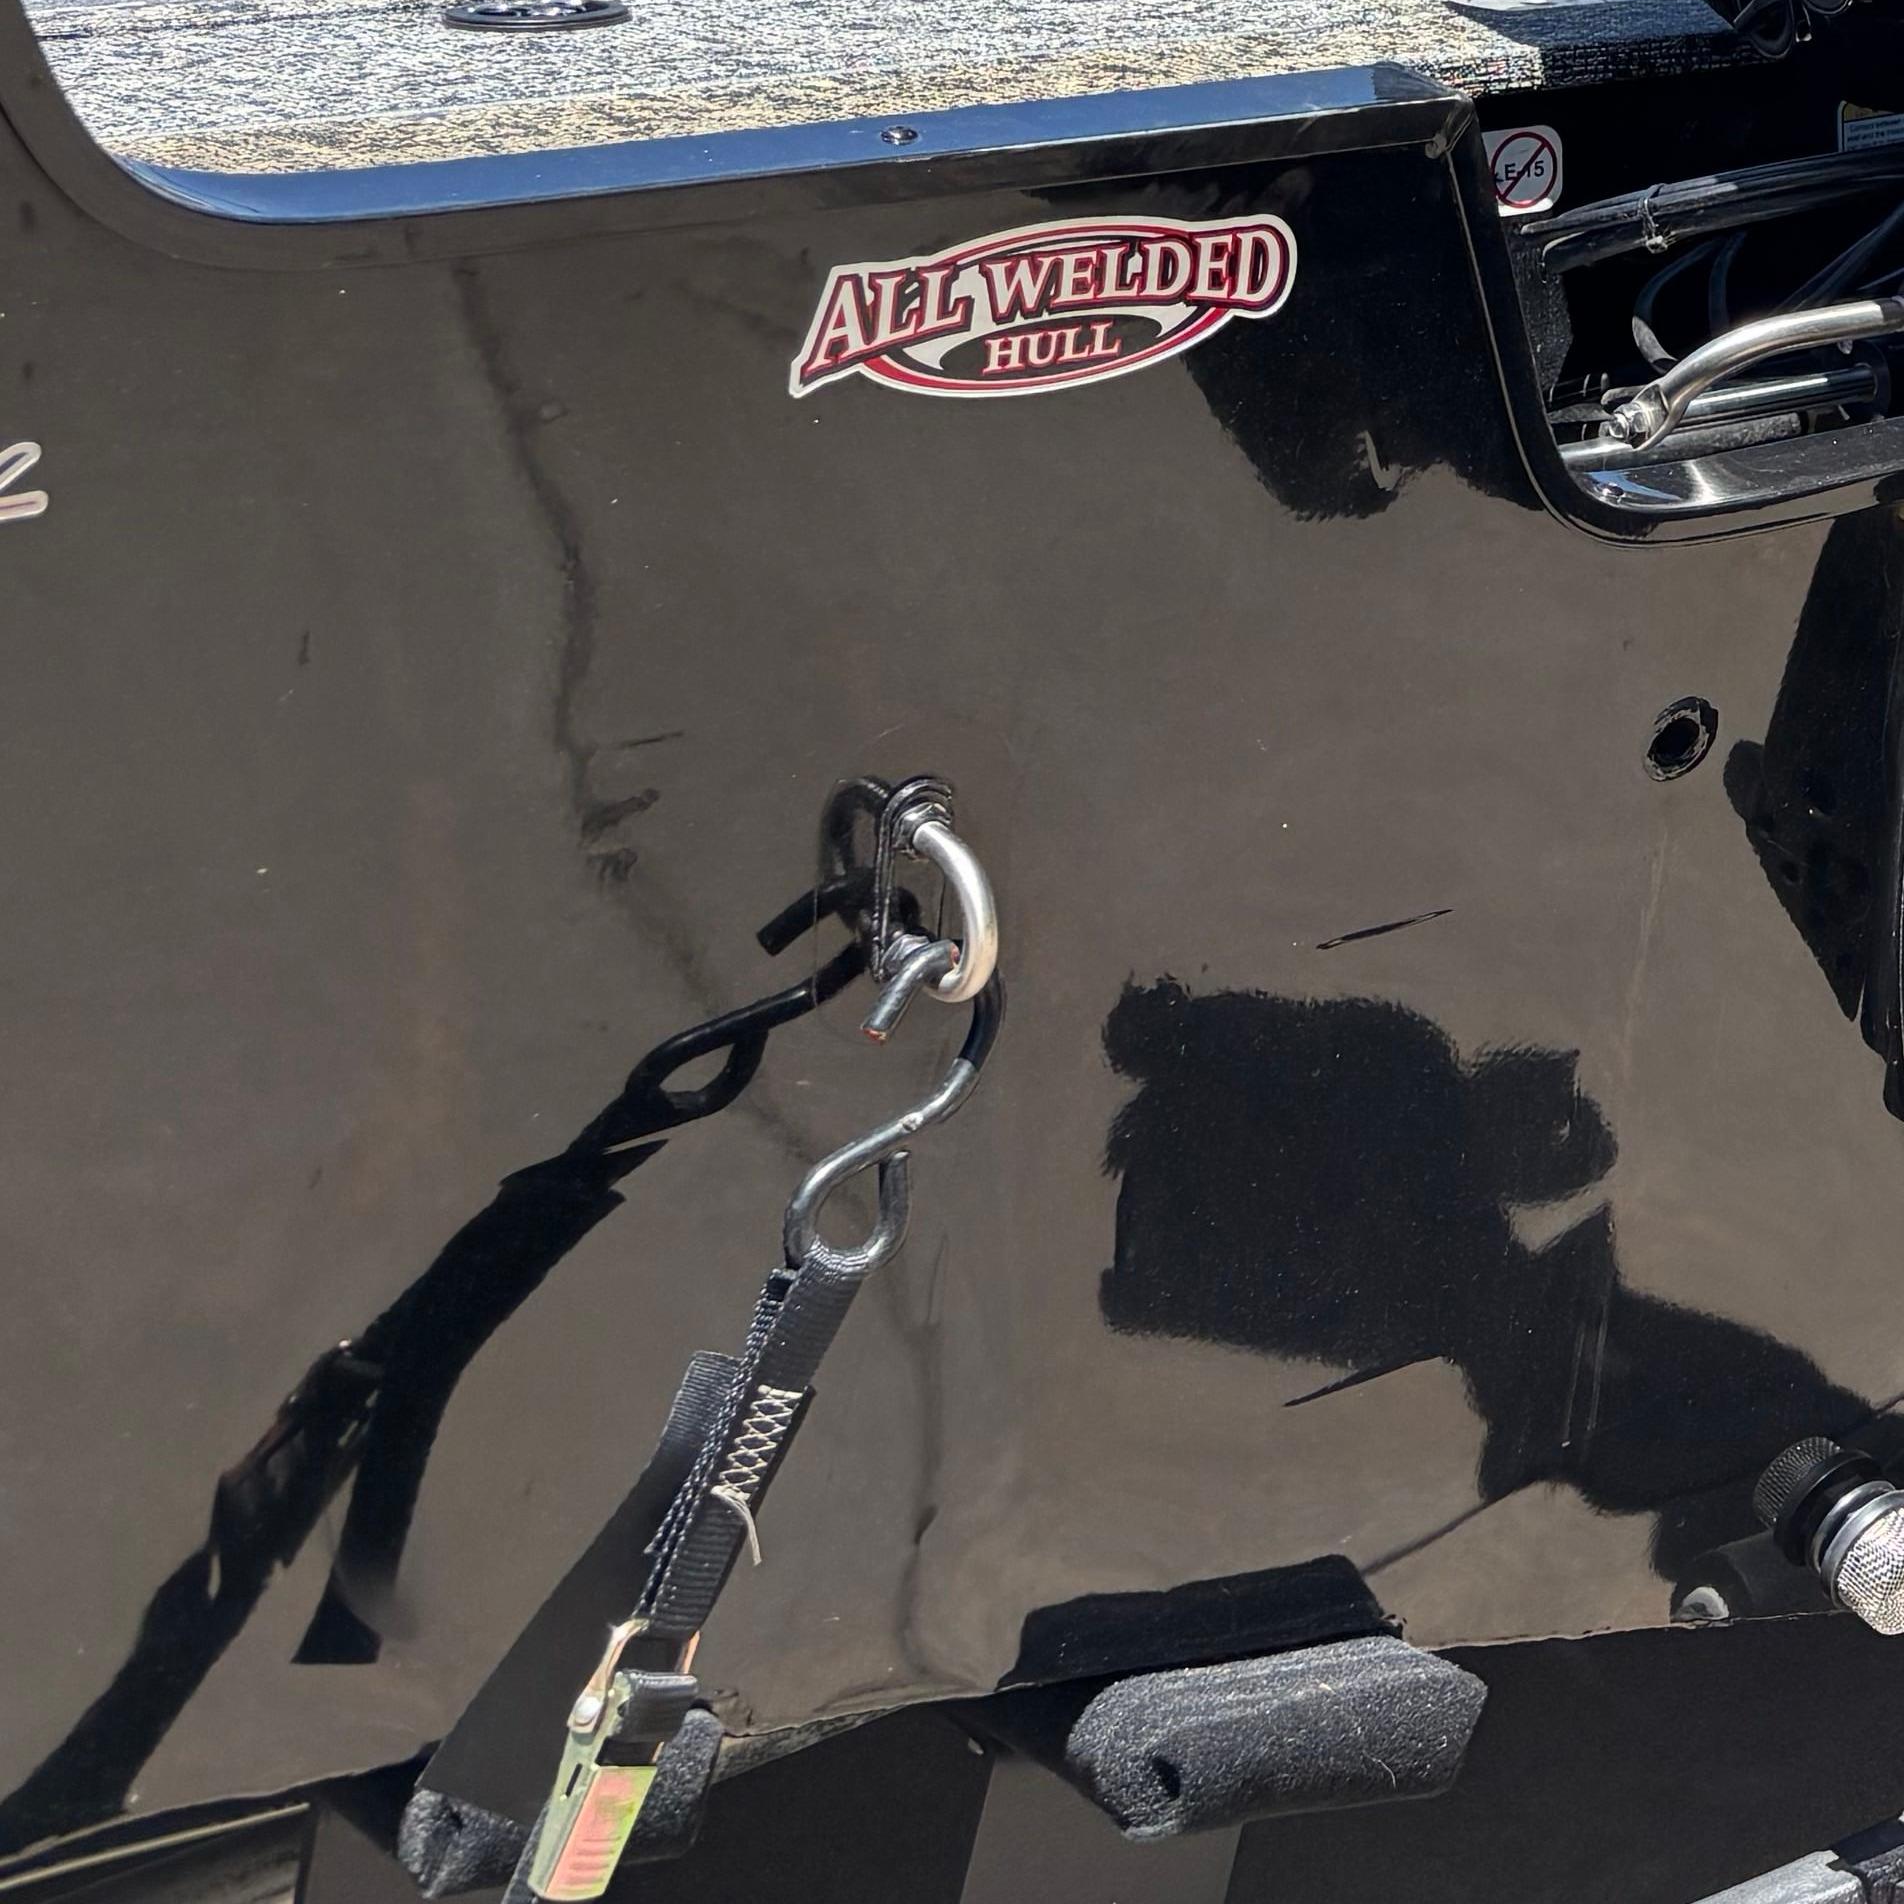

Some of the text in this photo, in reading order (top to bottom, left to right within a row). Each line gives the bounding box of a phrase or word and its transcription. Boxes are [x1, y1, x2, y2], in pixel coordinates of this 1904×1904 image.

[802, 227, 1286, 373] ALL WELDED
[982, 319, 1123, 375] HULL
